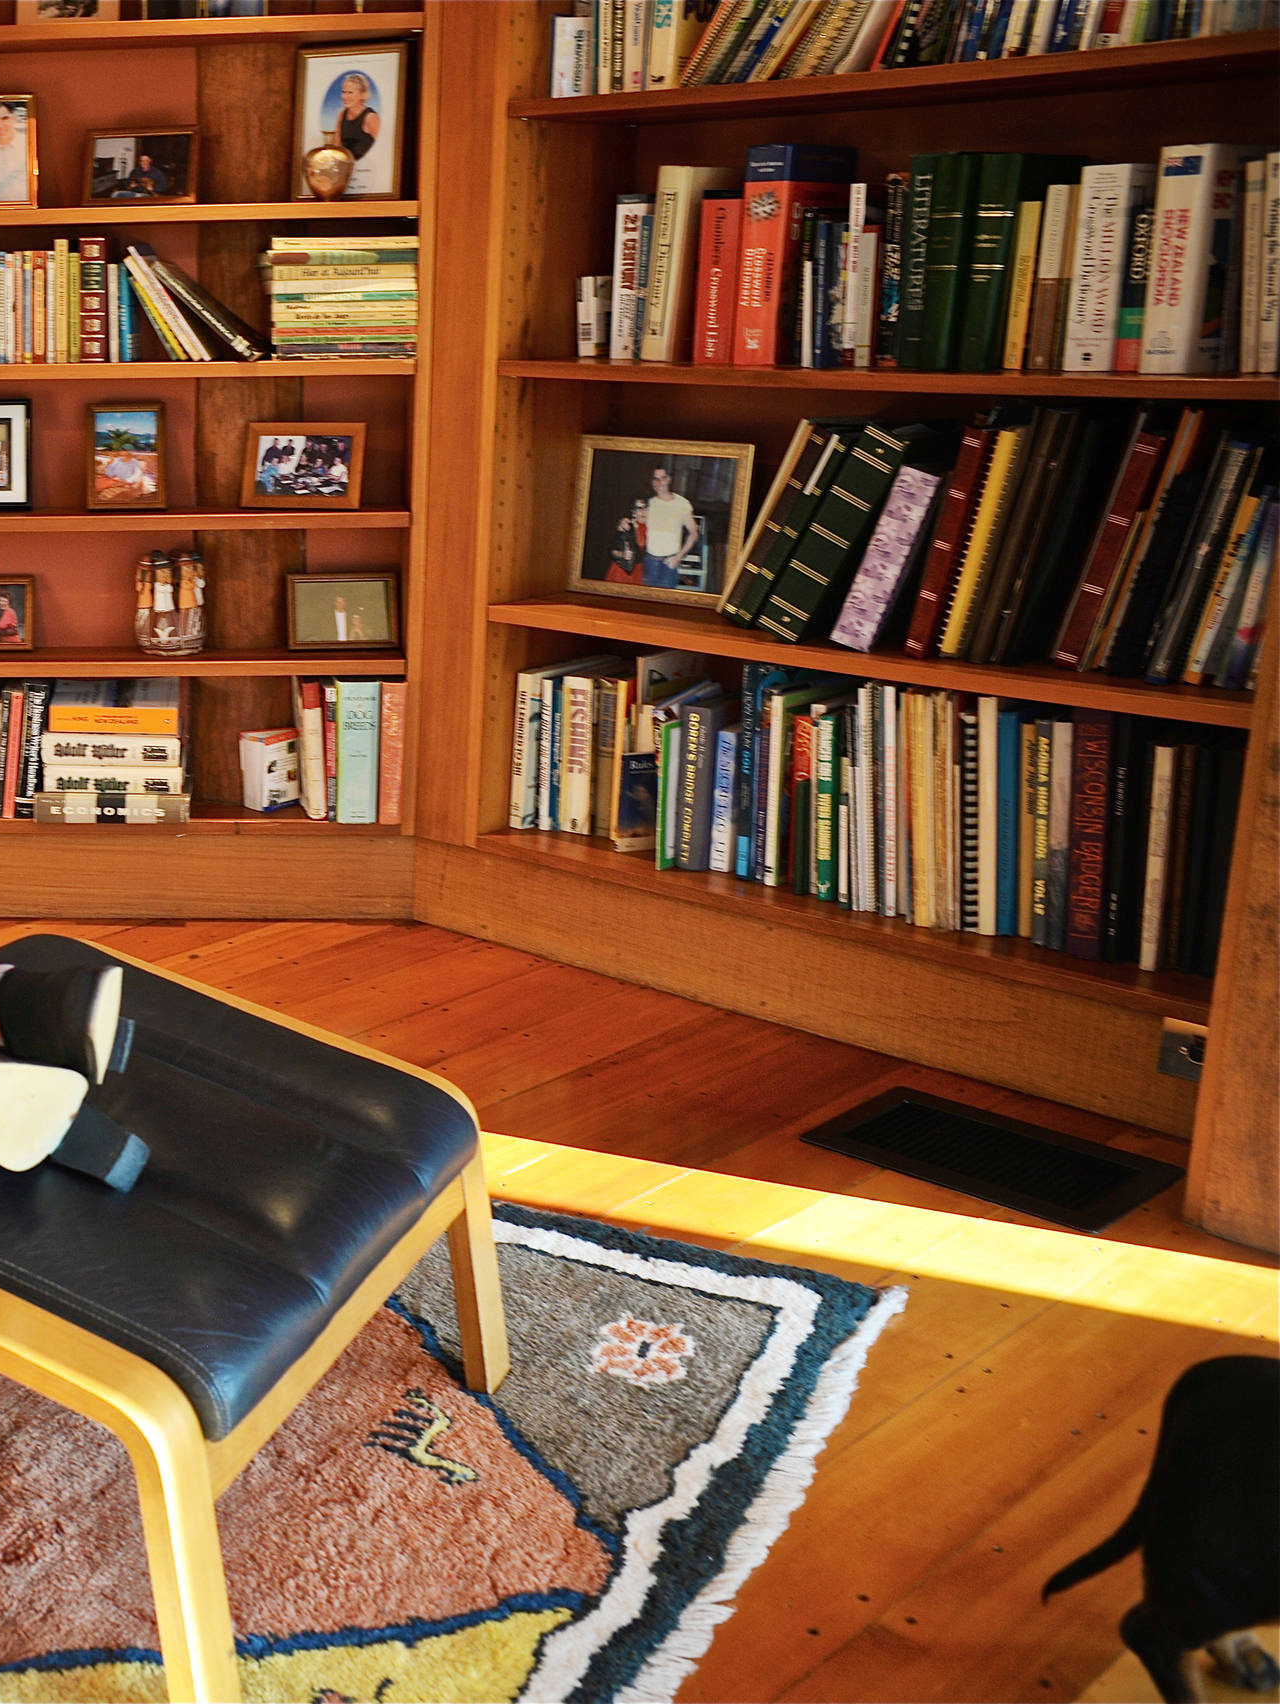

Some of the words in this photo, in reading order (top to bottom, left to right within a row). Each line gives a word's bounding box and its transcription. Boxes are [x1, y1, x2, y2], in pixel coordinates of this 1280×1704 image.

[659, 191, 676, 240] Reverse
[712, 206, 726, 267] Chambers
[1173, 209, 1191, 240] NEW
[1264, 197, 1279, 239] Writing
[620, 237, 637, 291] CENTURY
[1098, 220, 1116, 284] MILLION
[1128, 214, 1150, 280] OXFORD
[1152, 209, 1174, 308] ENCYCLOPEDIA
[649, 243, 672, 309] Dictionary
[707, 267, 723, 328] Crossword
[739, 248, 756, 307] Dictionary
[751, 247, 767, 308] Crossword
[1167, 244, 1187, 308] ZEALAND
[1092, 288, 1110, 335] WORD
[1261, 298, 1276, 322] Way
[704, 331, 718, 358] Lists
[34, 691, 46, 704] The
[347, 710, 375, 720] DOG
[516, 706, 527, 747] LEARNED
[567, 688, 588, 774] FISHING
[686, 712, 700, 761] GOREN'S
[720, 740, 734, 757] The
[53, 742, 88, 758] Adolf
[90, 743, 128, 760] Hitler
[741, 750, 751, 775] GOLF
[1035, 736, 1050, 783] AGOURA
[55, 776, 90, 791] Adolf
[93, 777, 130, 792] Hitler
[683, 764, 697, 804] BRIDGE
[718, 758, 733, 810] SECRET
[1034, 785, 1049, 816] HIGH
[1074, 739, 1107, 835] WISCONSIN
[49, 806, 167, 817] ECONOMICS
[679, 807, 694, 865] COMPLETE
[1033, 817, 1048, 861] SCHOOL
[1071, 841, 1105, 910] BADGER
